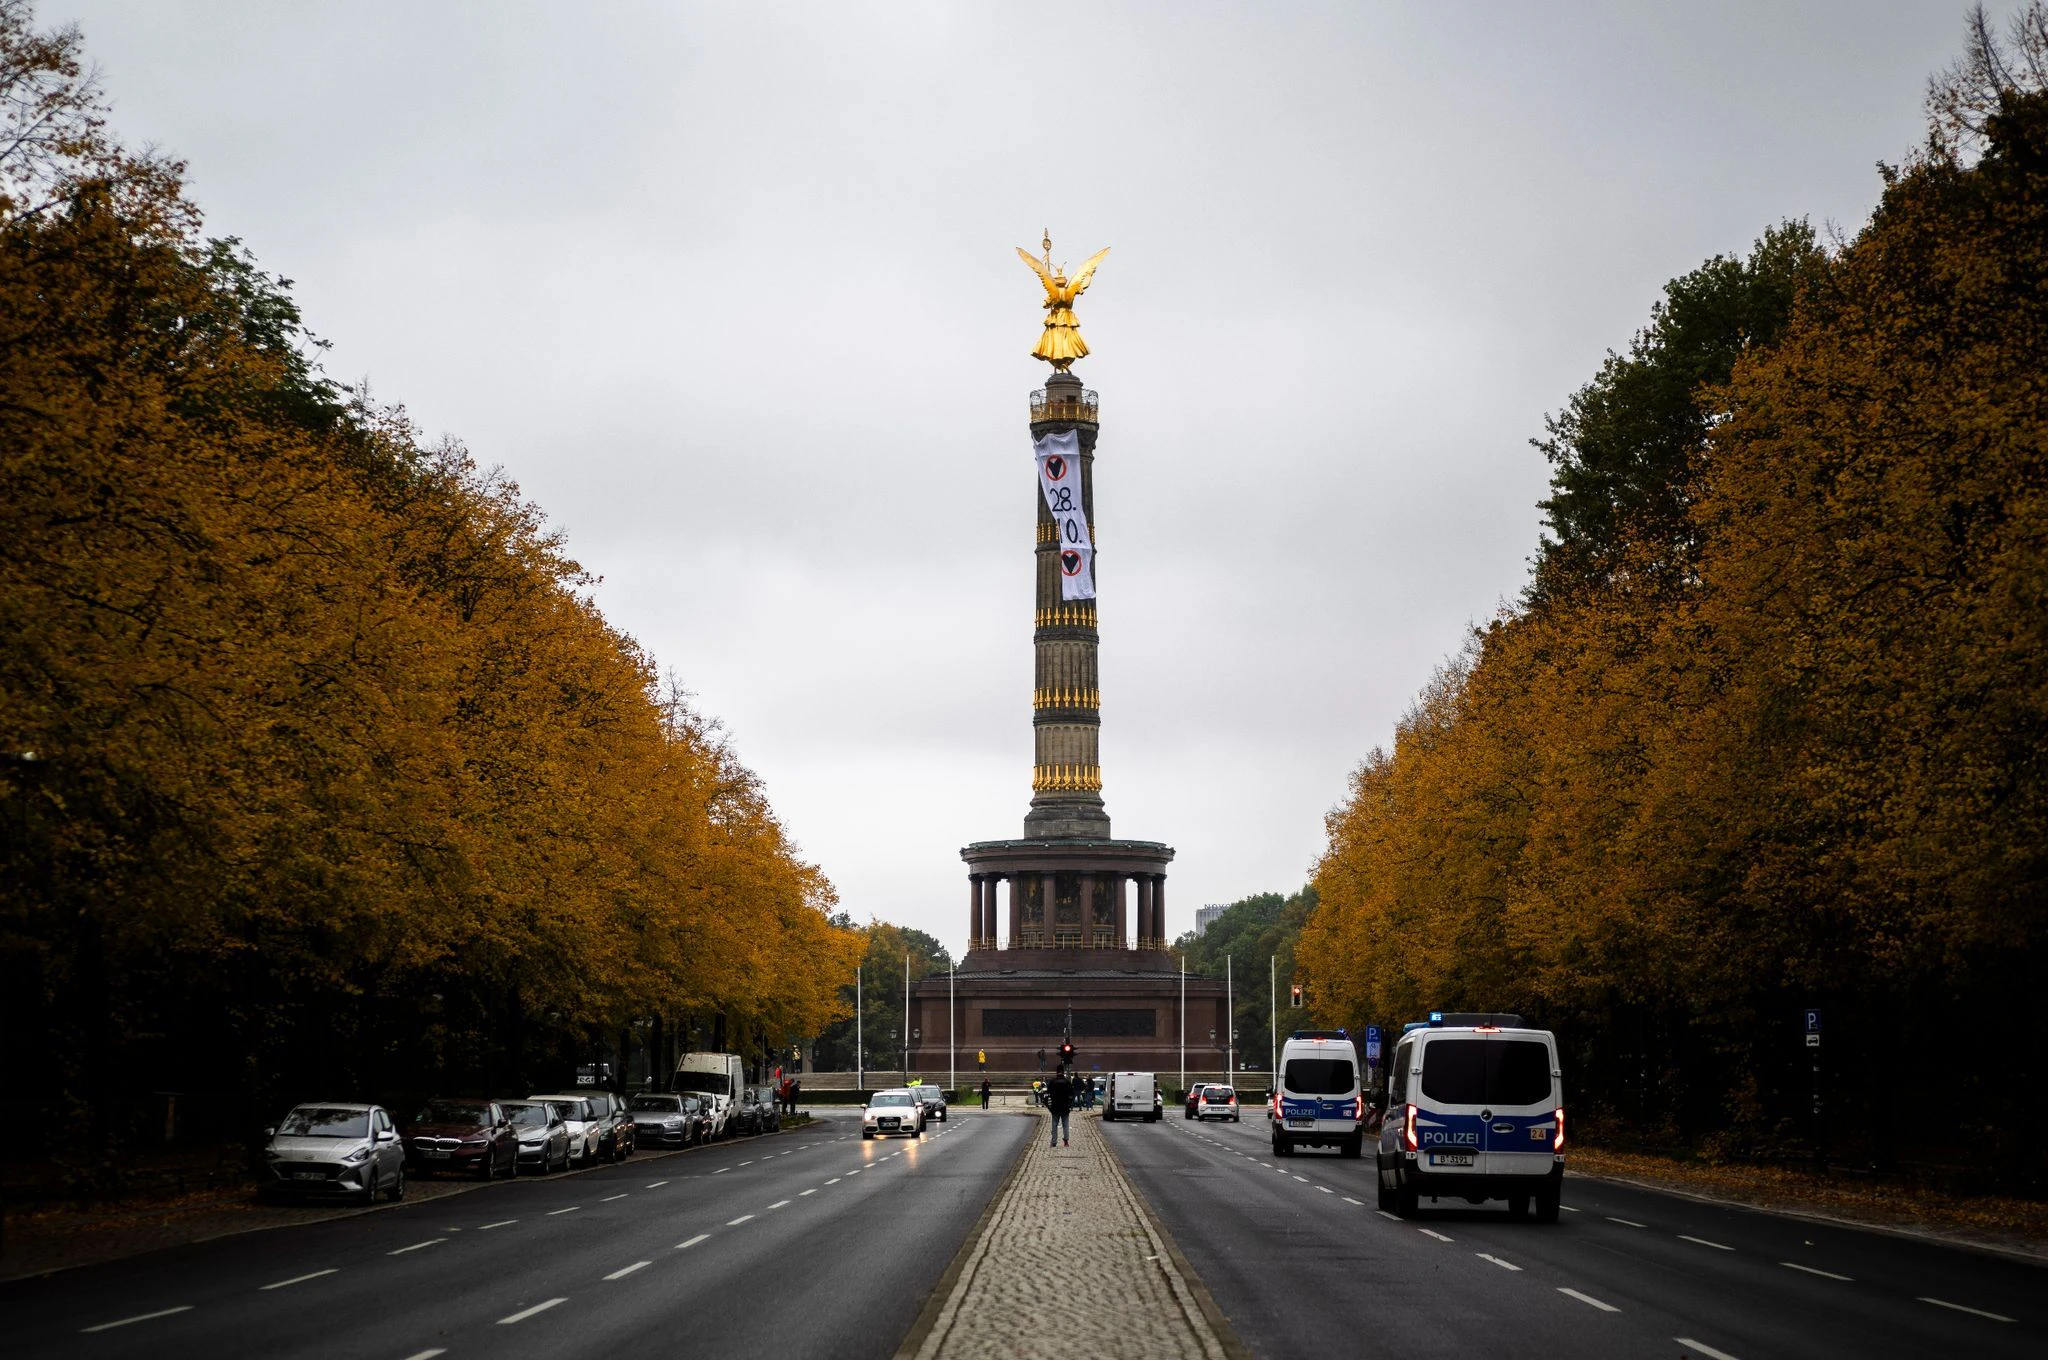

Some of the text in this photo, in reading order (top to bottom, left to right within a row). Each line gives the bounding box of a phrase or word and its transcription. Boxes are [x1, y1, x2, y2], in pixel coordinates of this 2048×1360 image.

[1050, 487, 1076, 512] 28.
[1057, 518, 1082, 543] 10.
[1808, 1012, 1816, 1030] P
[1369, 1027, 1377, 1040] P
[1285, 1108, 1316, 1116] POLIZEI
[1424, 1132, 1479, 1144] POLIZEI
[1532, 1129, 1544, 1139] 24
[1450, 1155, 1468, 1164] 3191
